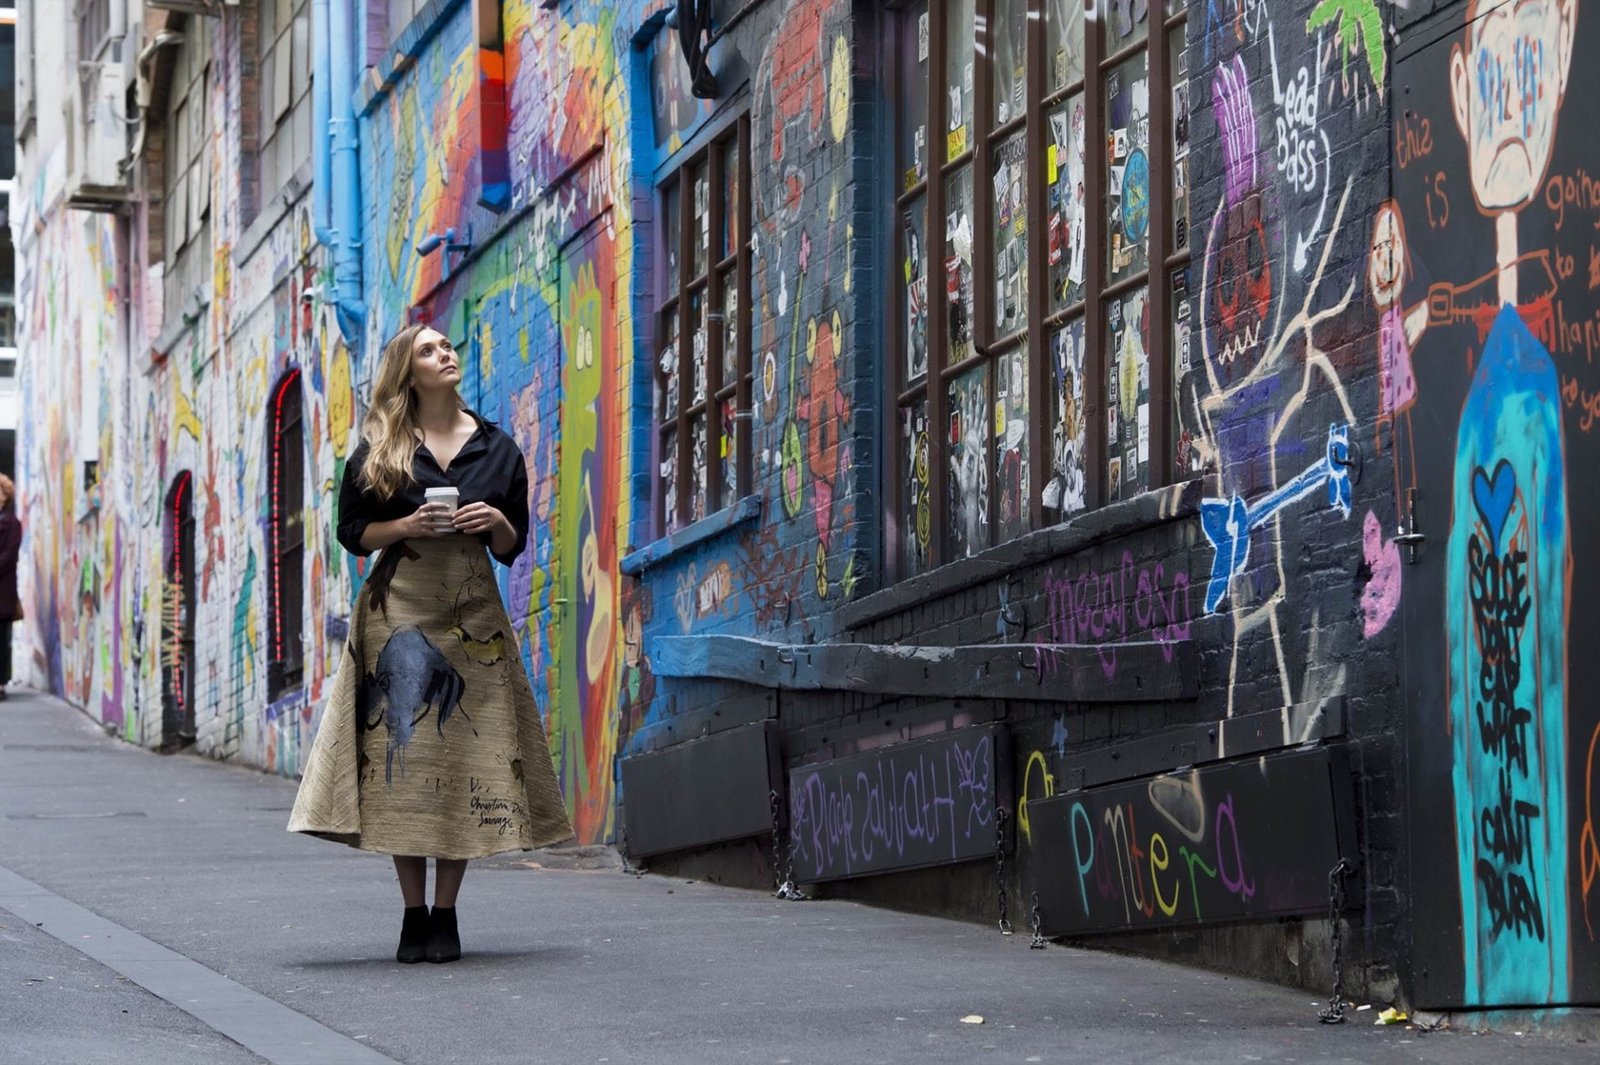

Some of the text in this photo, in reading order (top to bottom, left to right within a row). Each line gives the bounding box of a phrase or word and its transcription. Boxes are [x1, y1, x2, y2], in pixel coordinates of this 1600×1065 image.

[1269, 22, 1323, 133] Lead
[1276, 117, 1317, 194] Bass
[1424, 170, 1449, 228] is
[1555, 246, 1574, 280] to
